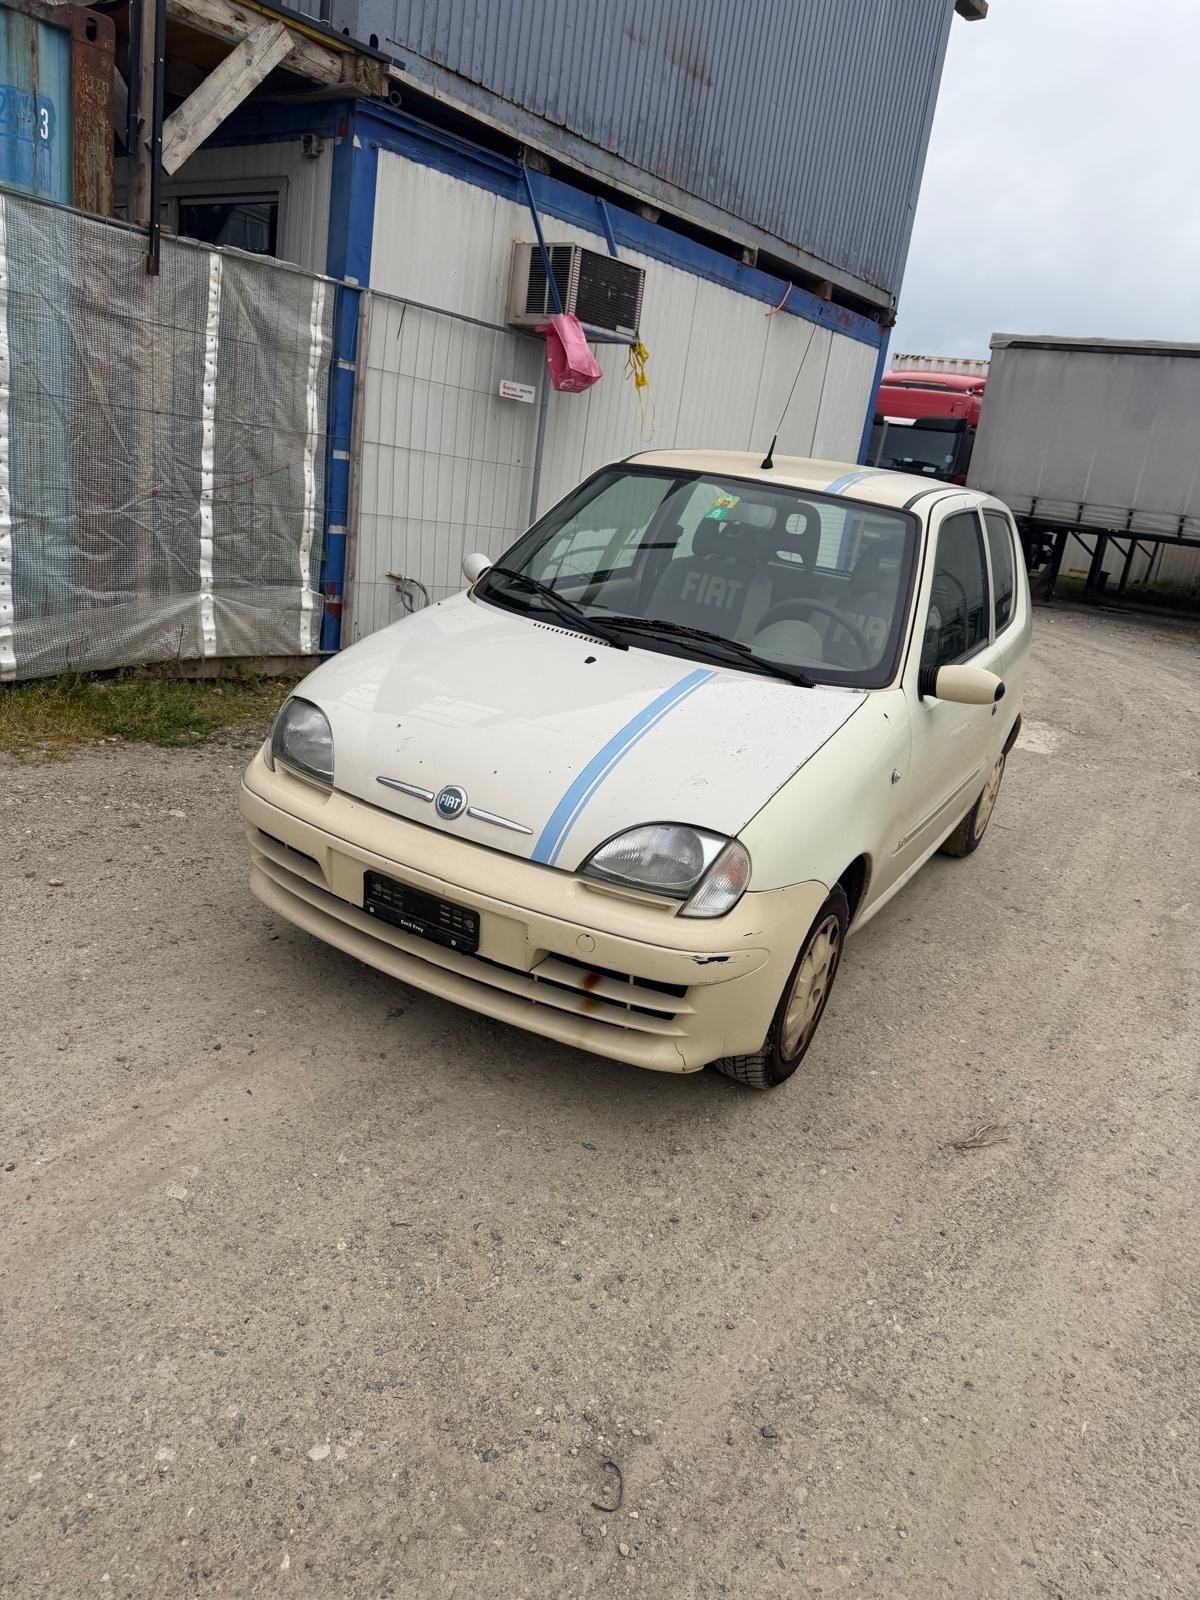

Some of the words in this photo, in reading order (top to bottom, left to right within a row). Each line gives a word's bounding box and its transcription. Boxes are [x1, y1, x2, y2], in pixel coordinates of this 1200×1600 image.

[40, 107, 49, 140] 3
[680, 571, 743, 610] FIAT
[833, 611, 888, 650] FIA
[439, 794, 461, 809] FIAT
